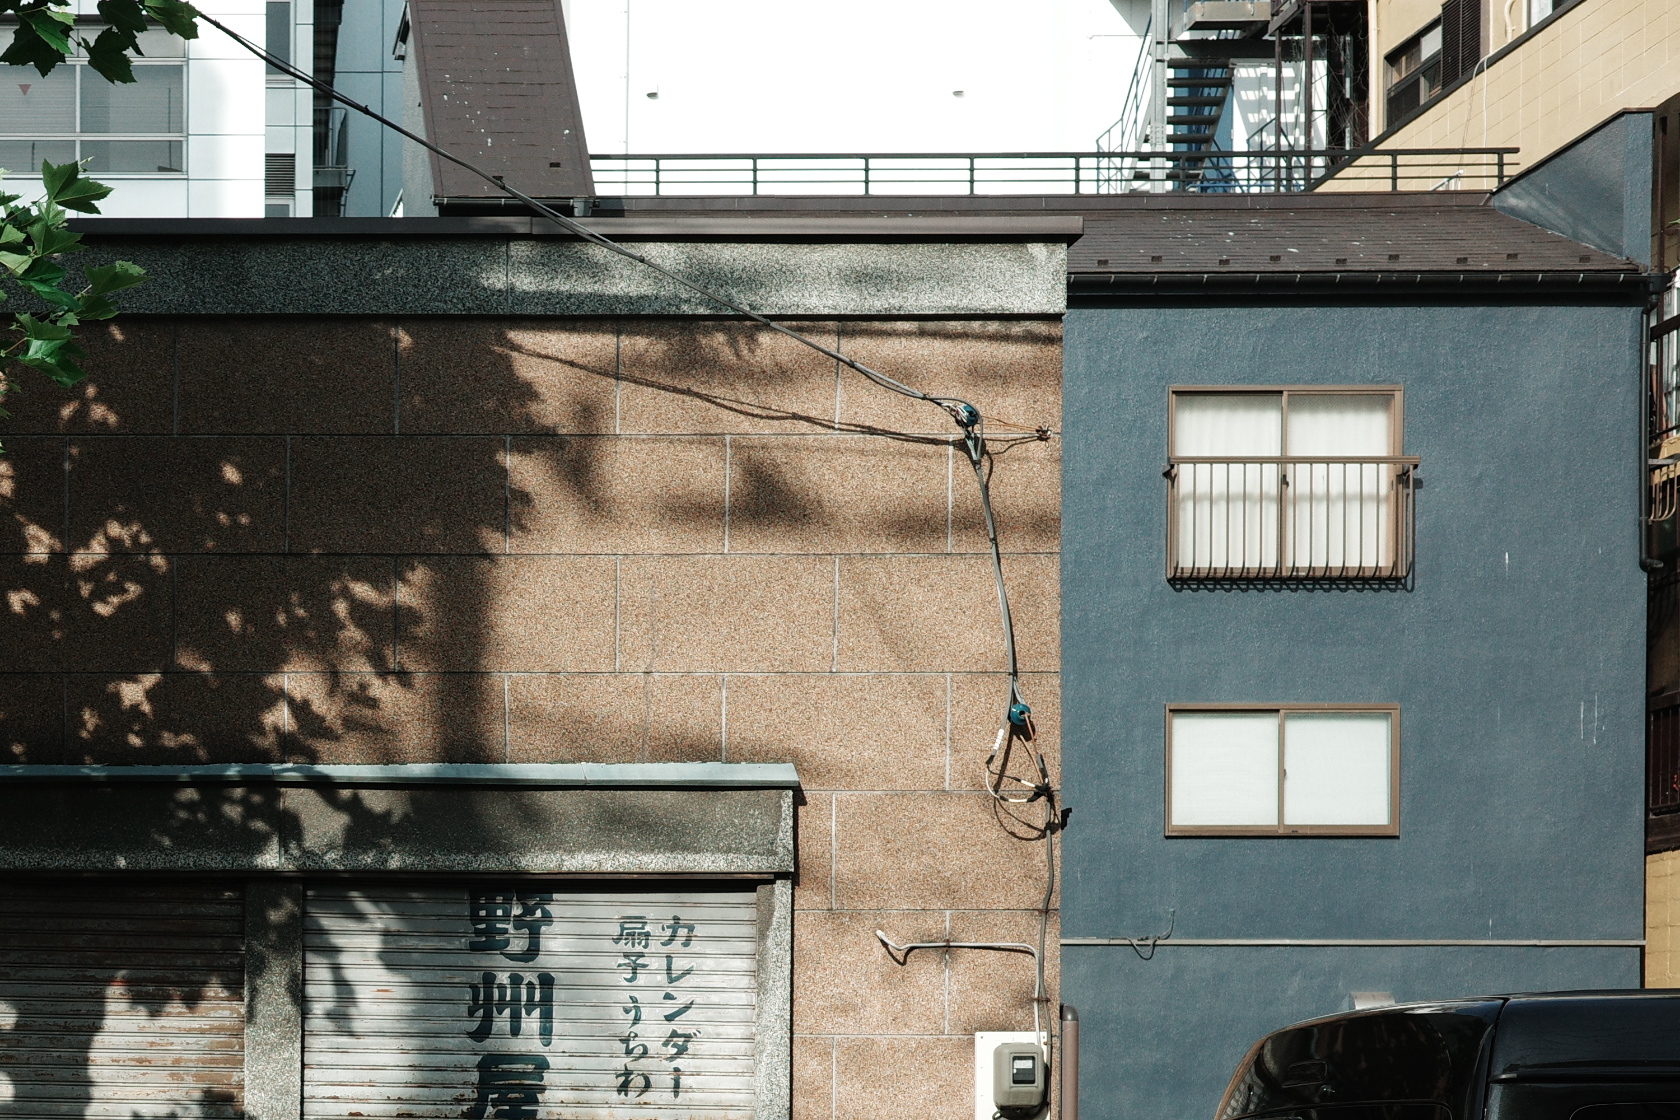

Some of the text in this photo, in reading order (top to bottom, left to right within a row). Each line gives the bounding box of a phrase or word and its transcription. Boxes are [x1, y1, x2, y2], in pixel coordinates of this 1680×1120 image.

[660, 915, 701, 1099] カレンダー
